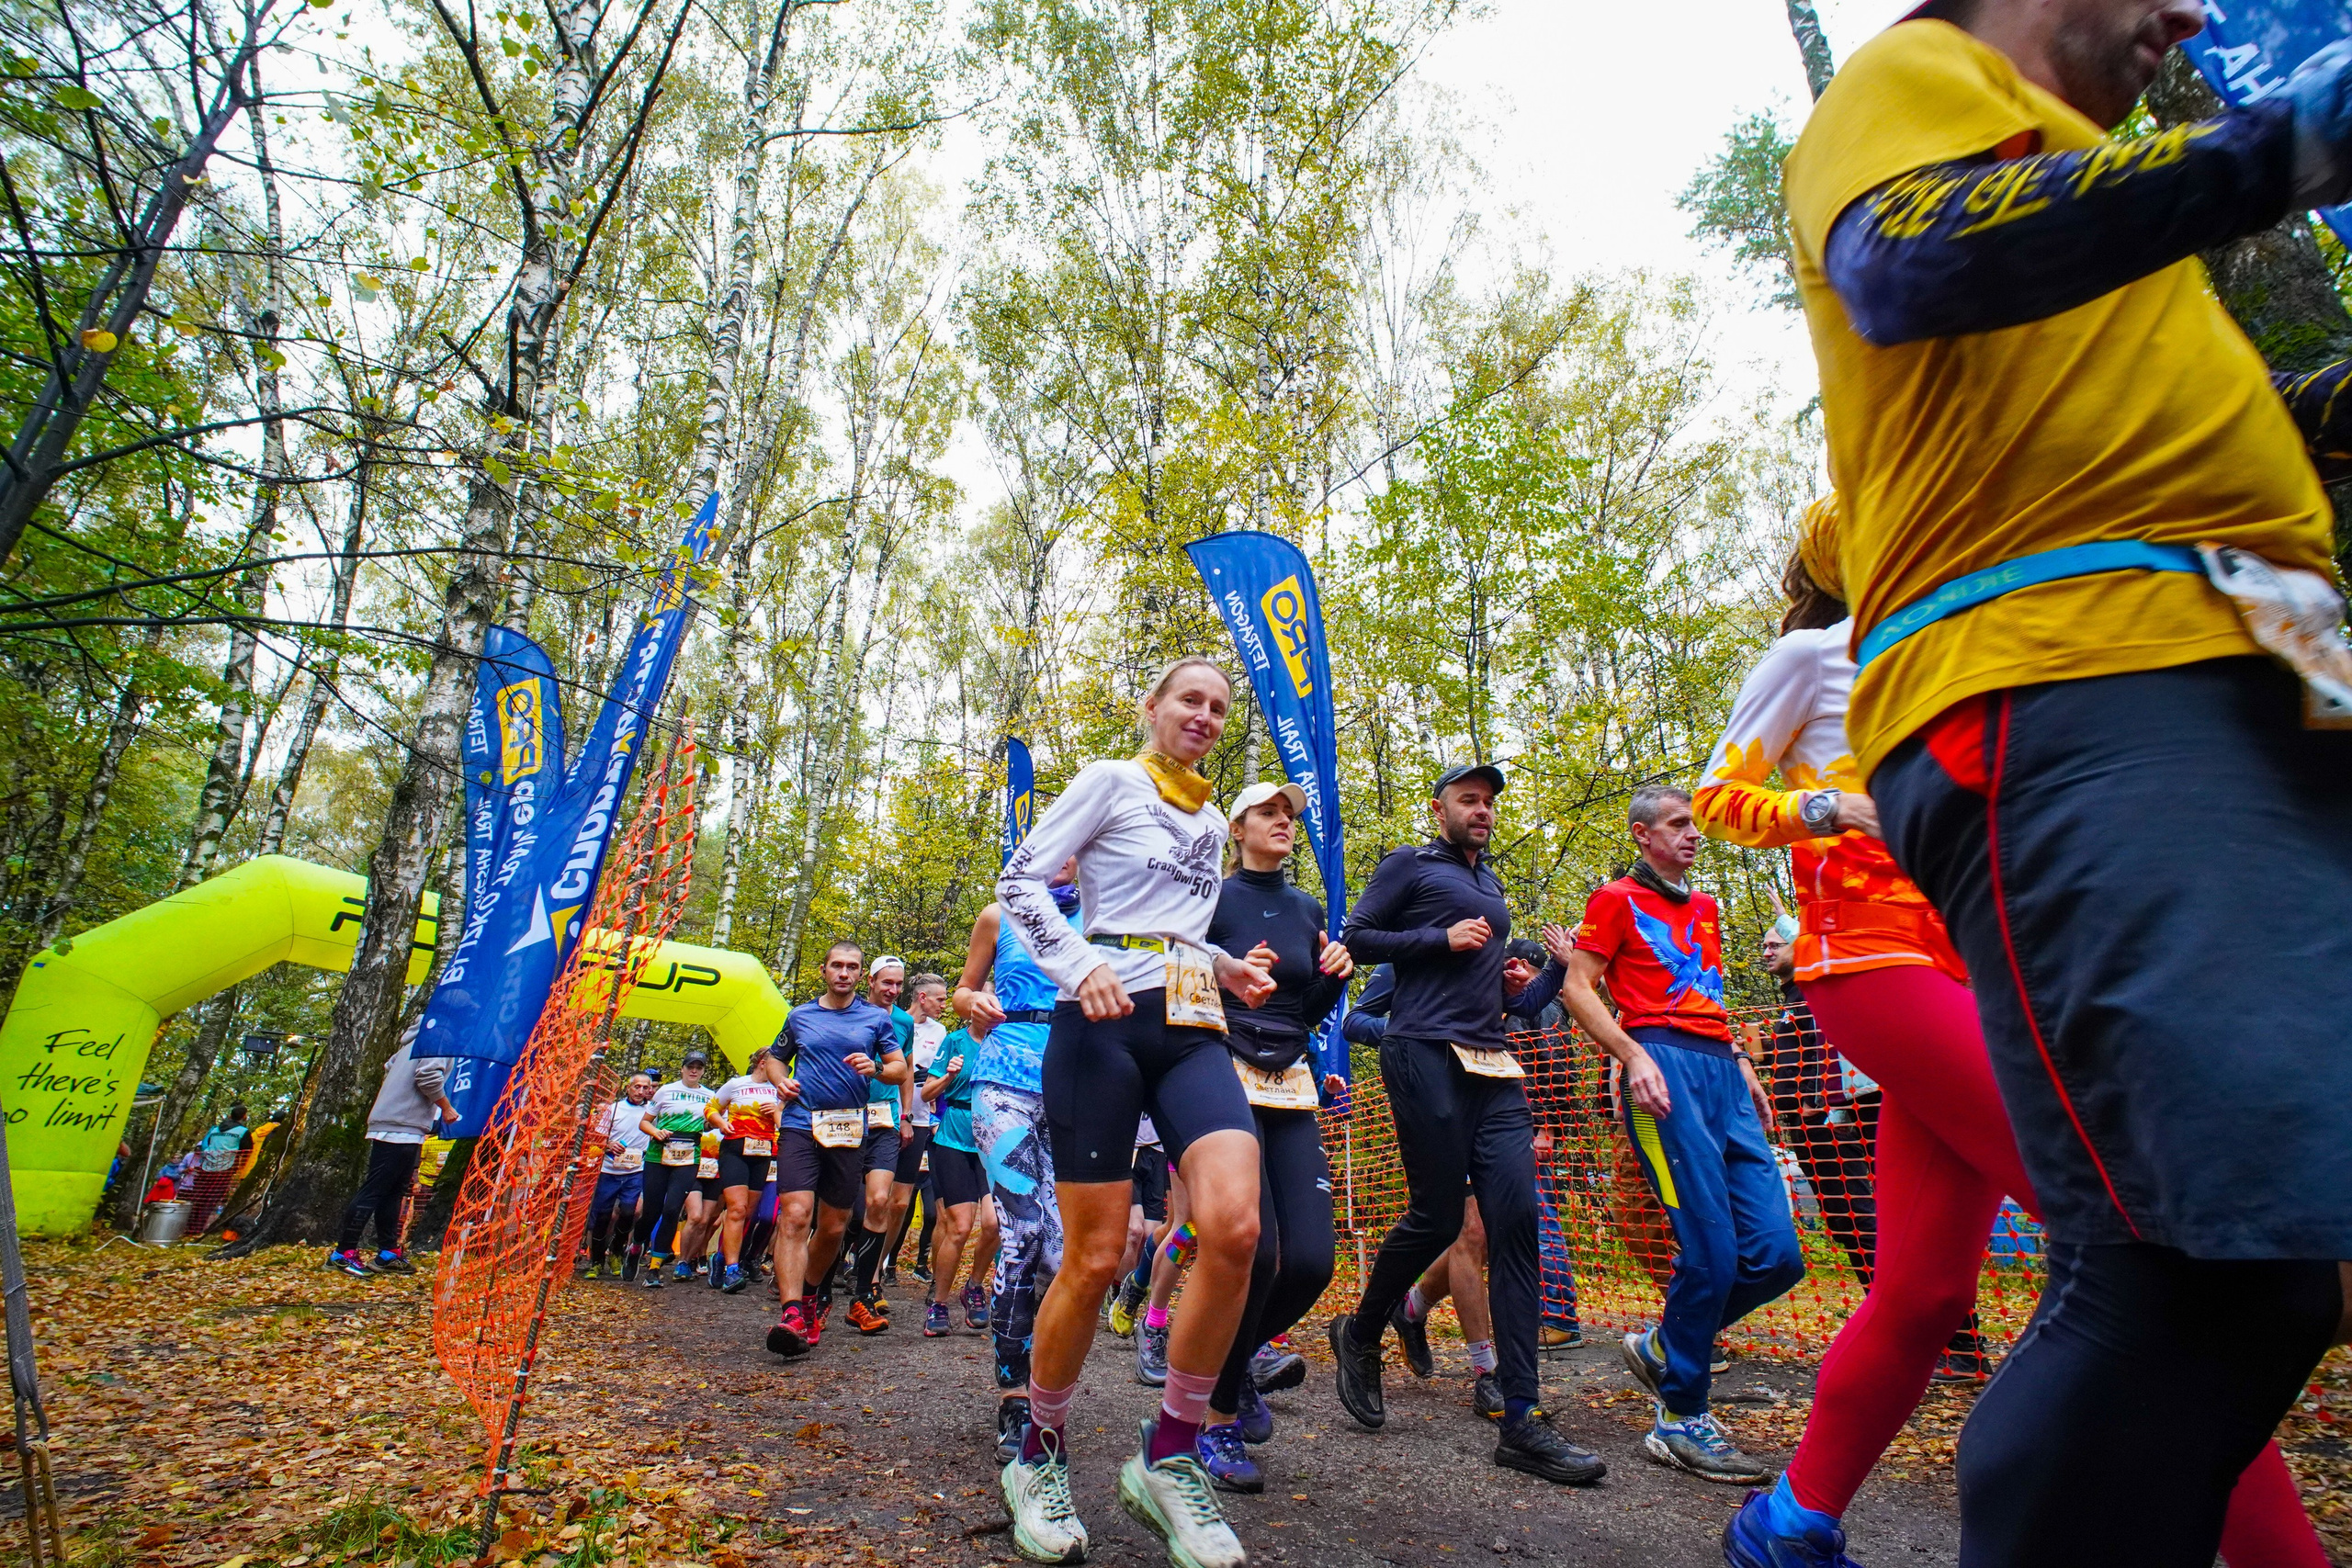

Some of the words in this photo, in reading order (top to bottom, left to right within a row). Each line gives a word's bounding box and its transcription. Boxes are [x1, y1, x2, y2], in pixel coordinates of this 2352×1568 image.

[1148, 857, 1178, 876] Crazy
[1190, 876, 1213, 899] 50
[44, 1029, 125, 1061] Feel
[17, 1062, 119, 1097] there's
[1254, 1083, 1296, 1094] Светлана
[44, 1098, 118, 1132] limit
[829, 1122, 851, 1133] 148
